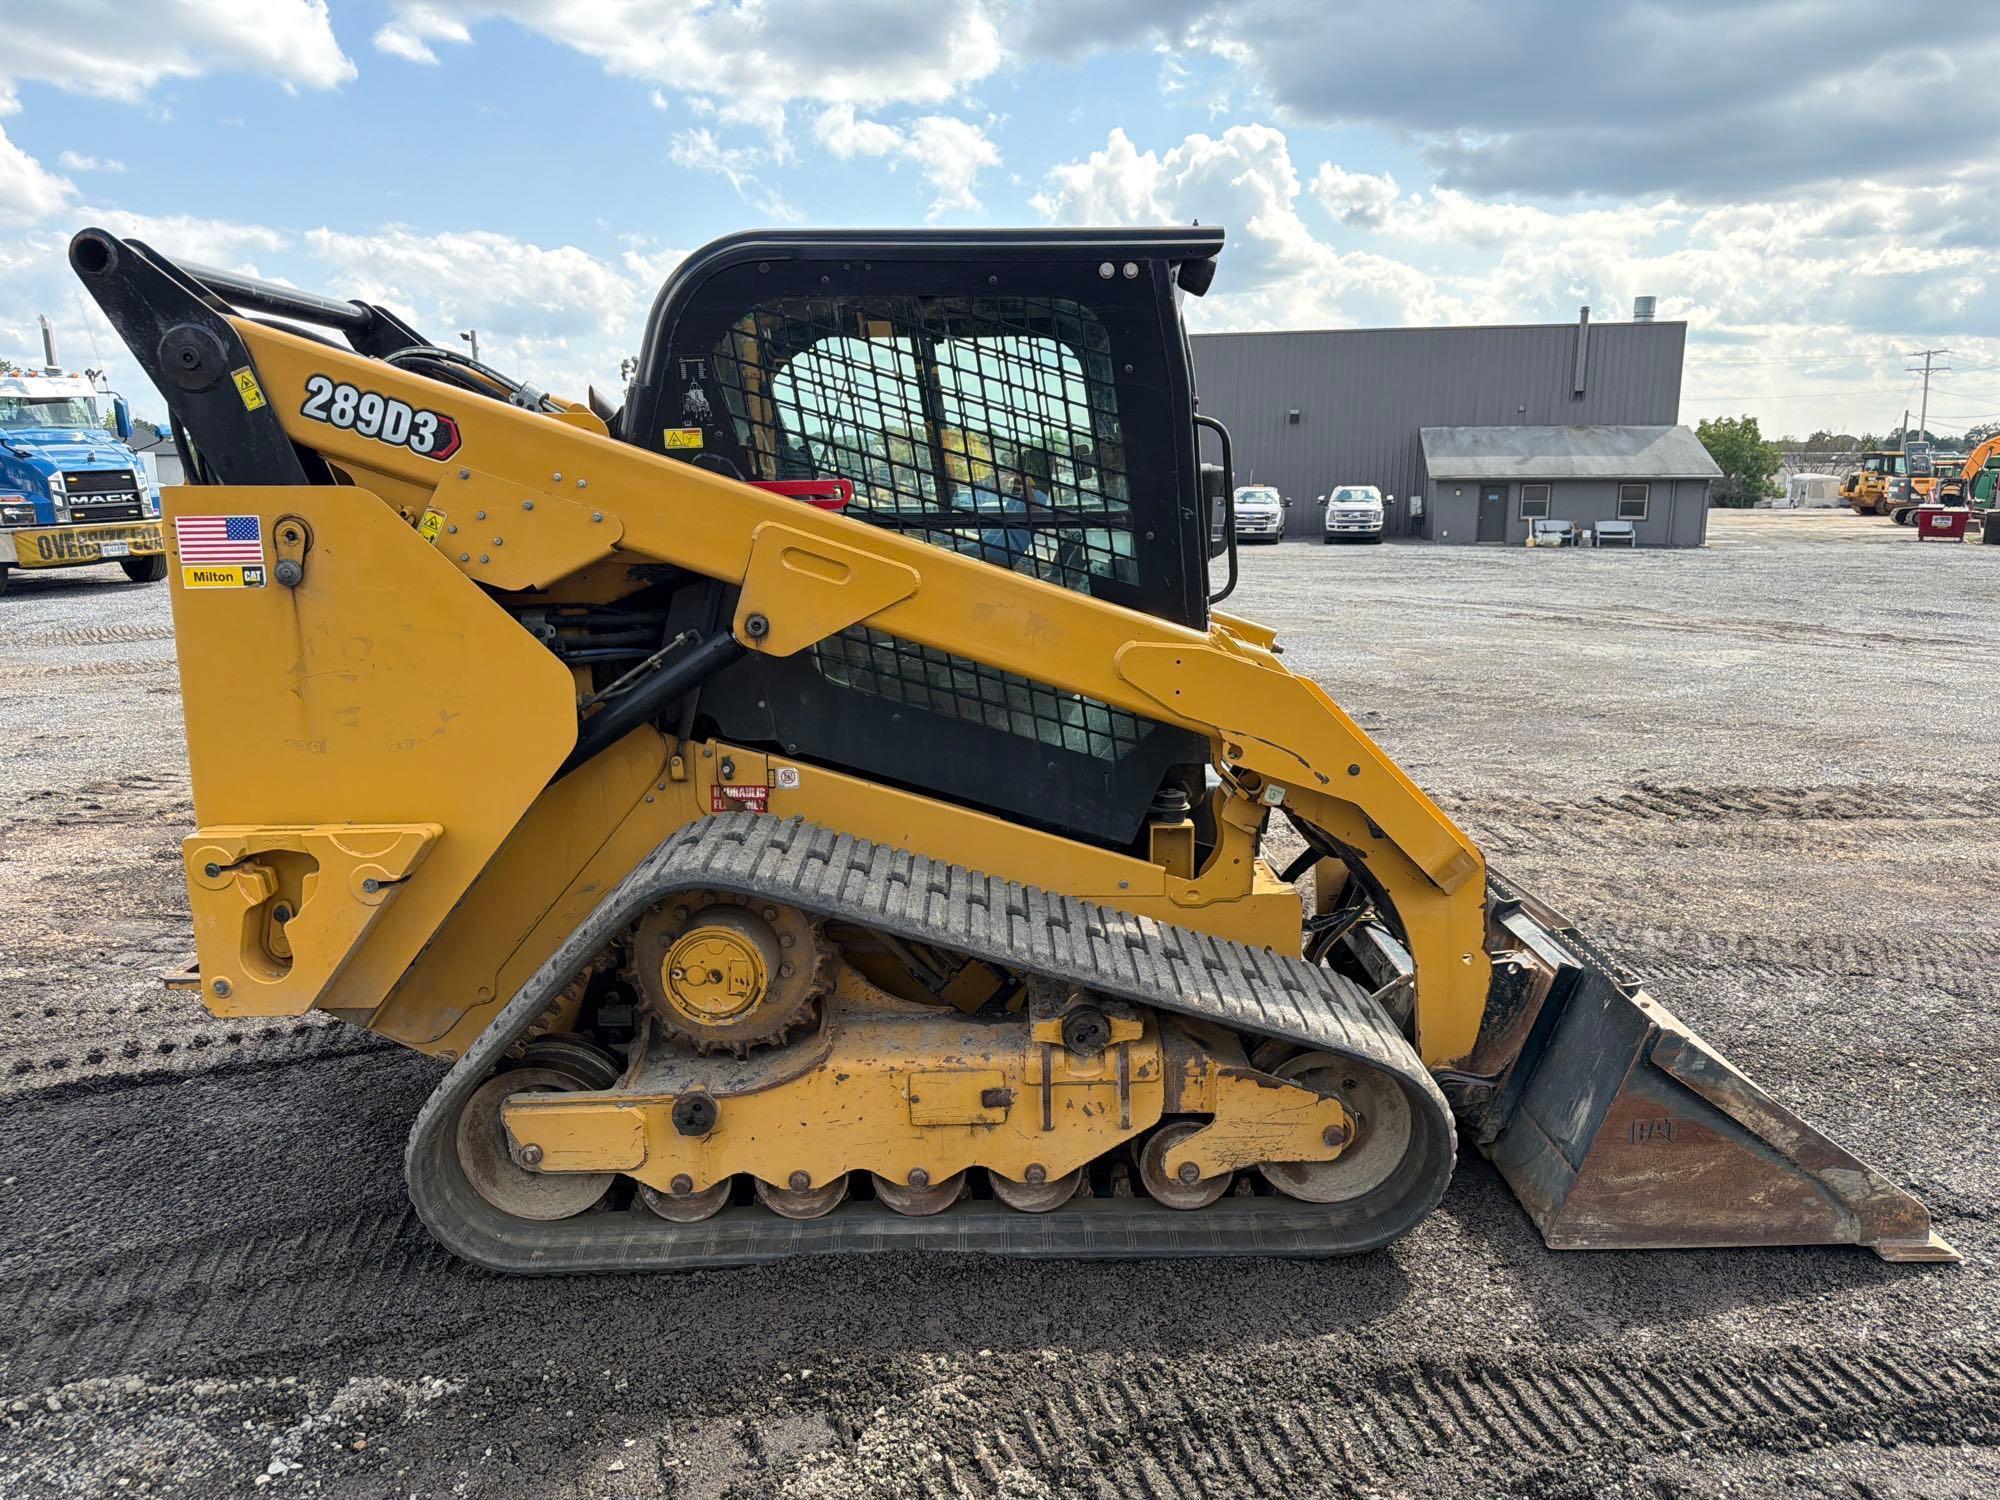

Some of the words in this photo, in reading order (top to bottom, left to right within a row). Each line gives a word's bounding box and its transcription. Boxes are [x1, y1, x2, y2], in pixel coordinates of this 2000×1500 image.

[302, 375, 438, 453] 289D3
[69, 493, 135, 505] MACK
[130, 526, 162, 551] LOA
[193, 571, 234, 582] Milton
[244, 570, 262, 582] CAT
[1630, 1118, 1680, 1144] CAT
